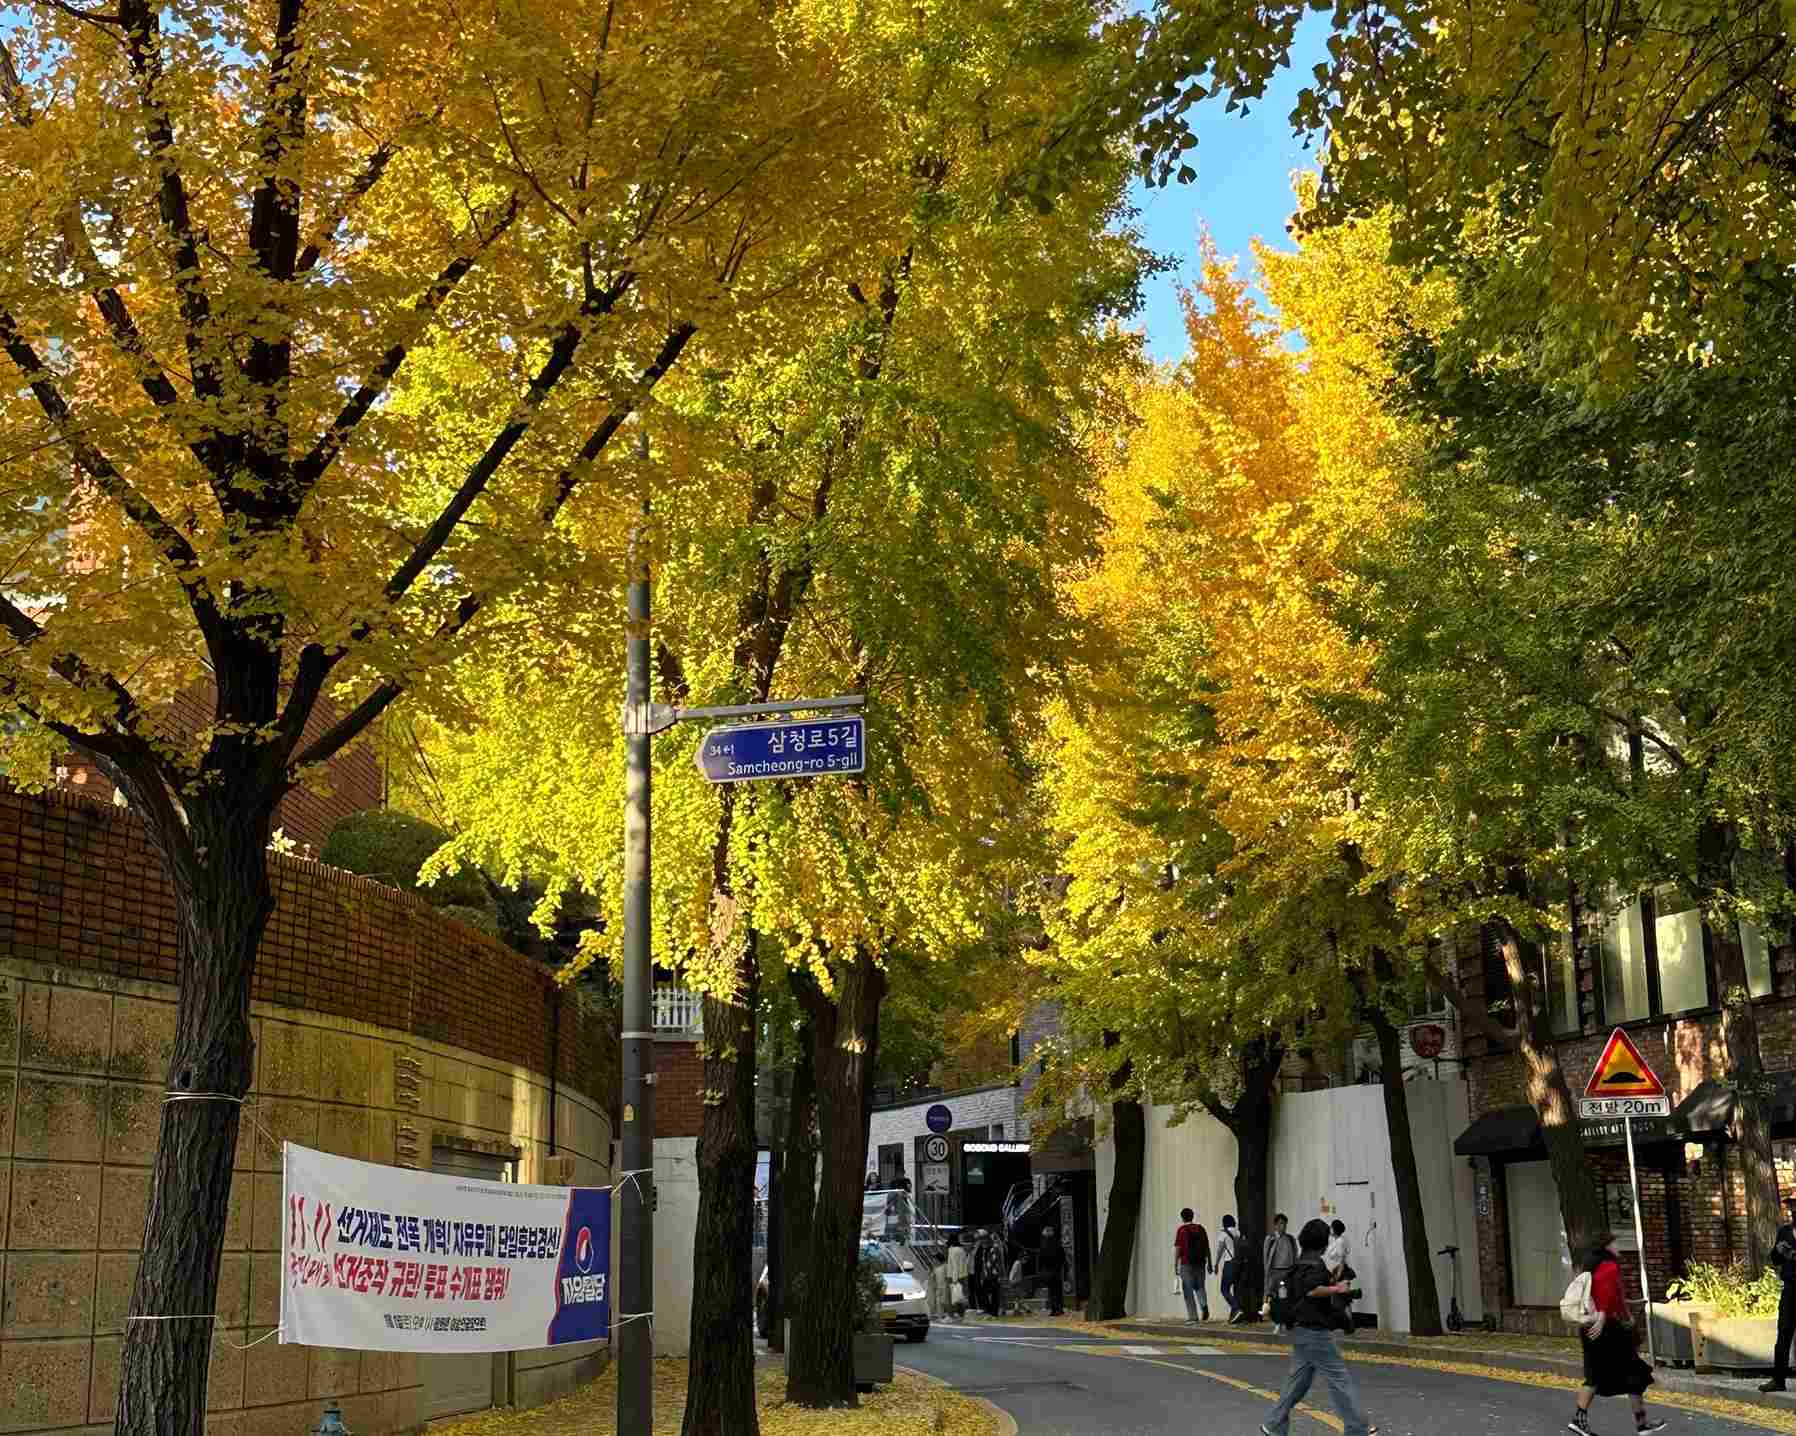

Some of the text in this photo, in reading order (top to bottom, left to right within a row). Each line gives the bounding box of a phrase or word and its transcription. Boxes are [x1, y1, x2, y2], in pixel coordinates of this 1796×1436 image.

[768, 725, 857, 754] 삼청로5길
[728, 752, 857, 777] Samcheong-ro 5-gil
[1623, 1100, 1661, 1113] 20m
[930, 1141, 945, 1157] 30
[337, 1206, 562, 1259] 선거제도 전폭 개혁! 자유우파 단일후보경선!
[334, 1253, 388, 1296] 선거조작
[389, 1261, 424, 1299] 규탄!
[424, 1264, 448, 1300] 투표
[450, 1265, 482, 1301] 수개표
